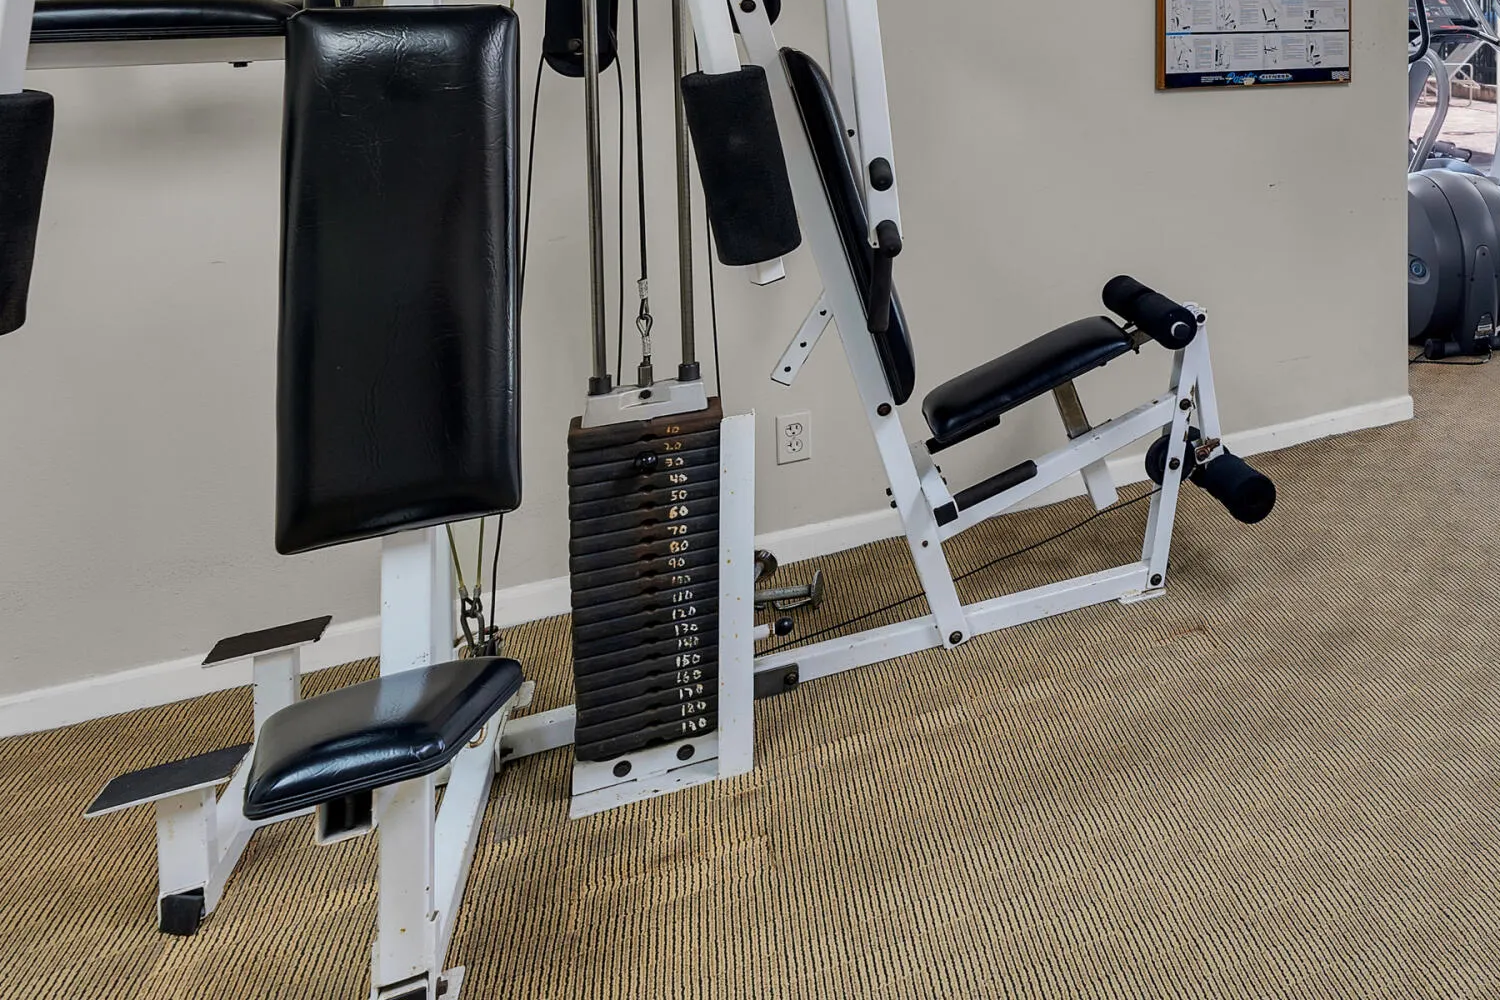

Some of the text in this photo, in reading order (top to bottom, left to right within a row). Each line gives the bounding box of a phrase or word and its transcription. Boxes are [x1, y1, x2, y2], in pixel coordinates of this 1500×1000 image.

[666, 425, 680, 434] 10
[669, 473, 688, 484] 40
[670, 490, 688, 501] 50
[669, 505, 689, 519] 60
[667, 525, 687, 535] 70
[669, 540, 689, 553] 80
[668, 557, 685, 568] 90
[672, 606, 697, 620] 120
[674, 623, 698, 636] 130
[676, 654, 701, 668] 150
[677, 669, 702, 683] 160
[680, 683, 704, 700] 170
